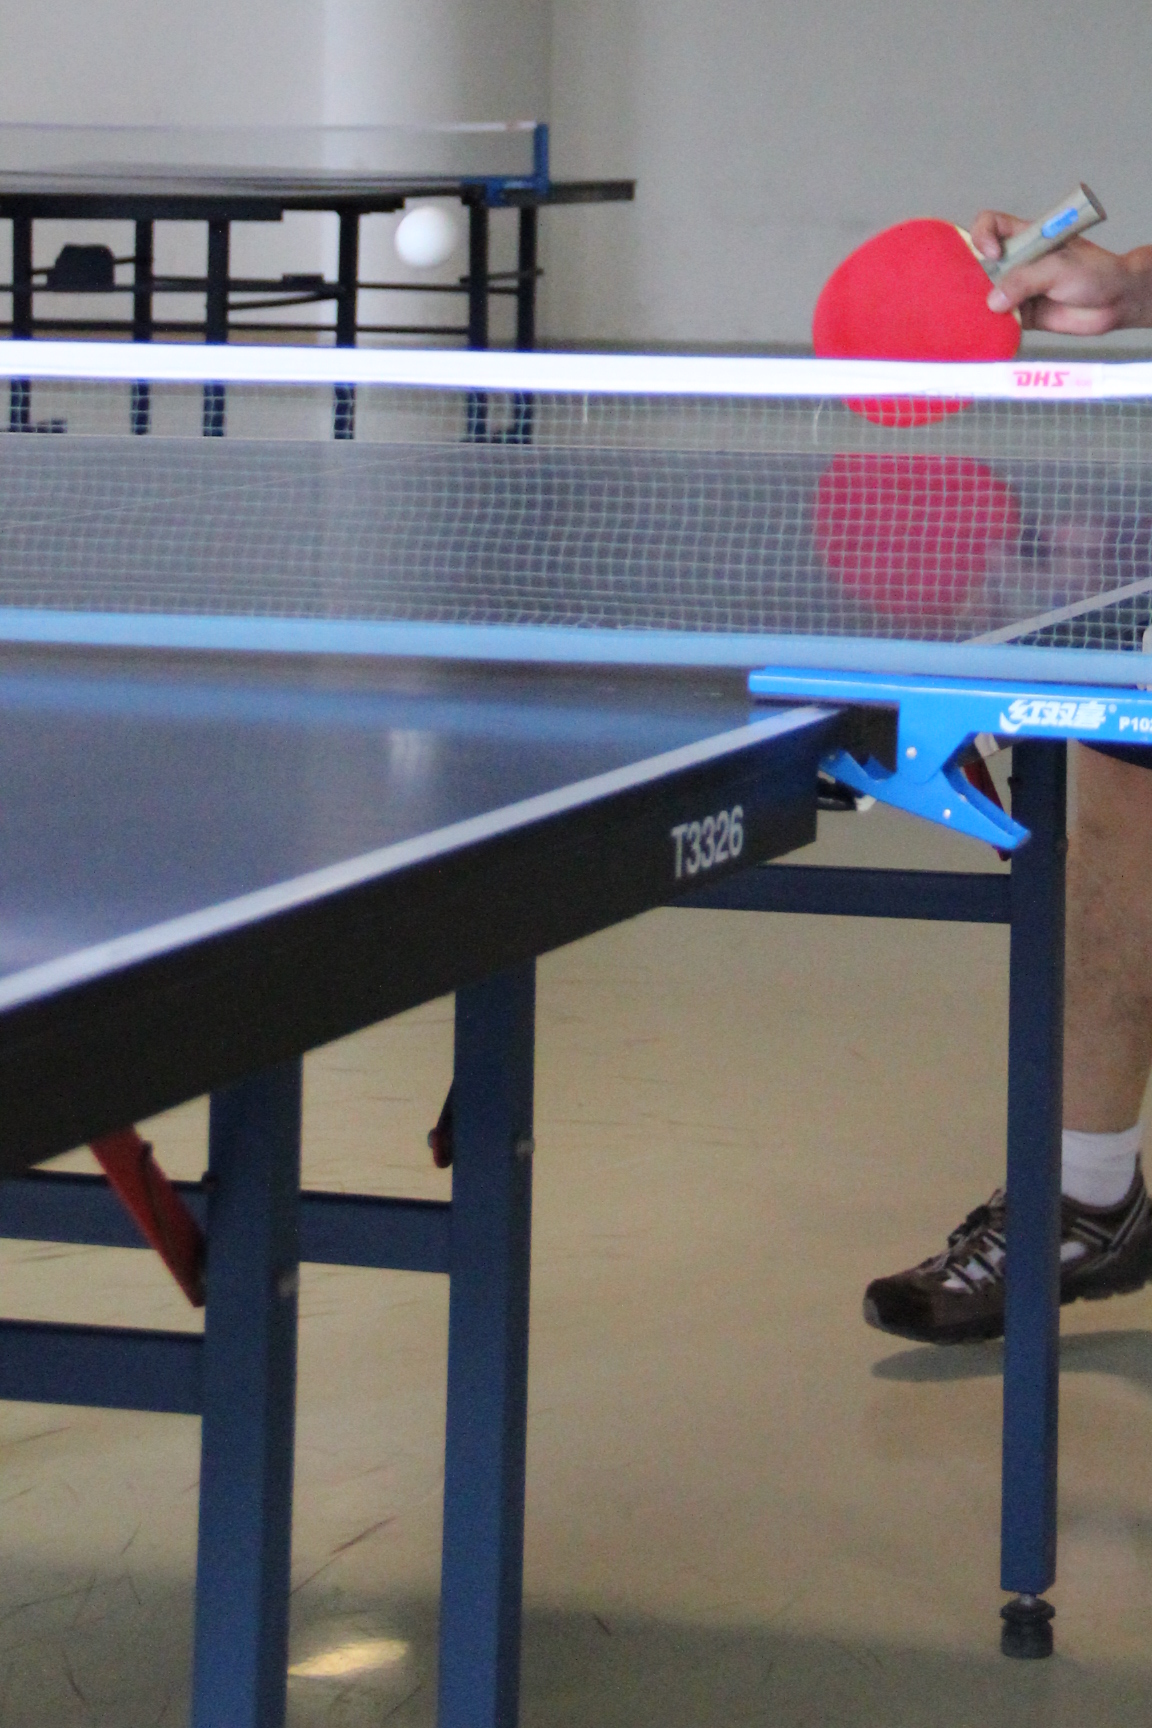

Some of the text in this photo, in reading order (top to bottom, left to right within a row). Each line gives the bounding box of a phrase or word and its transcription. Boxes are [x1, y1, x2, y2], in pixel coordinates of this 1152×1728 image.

[1012, 370, 1070, 387] DHS
[1002, 699, 1107, 732] 红双喜
[670, 804, 744, 879] T3326
